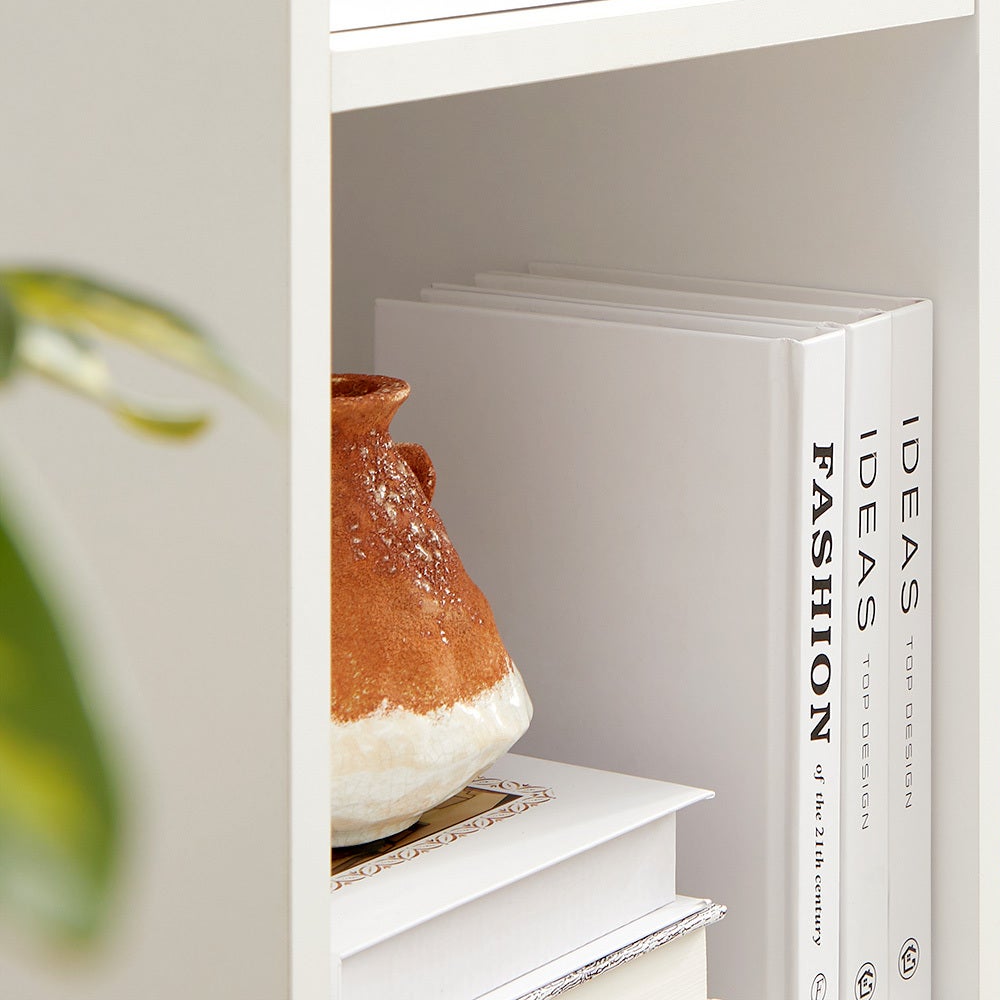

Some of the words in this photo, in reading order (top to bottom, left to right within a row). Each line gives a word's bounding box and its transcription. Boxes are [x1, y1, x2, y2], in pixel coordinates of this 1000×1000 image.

[857, 429, 878, 632] IDEAS
[901, 416, 919, 614] IDEAS
[810, 442, 834, 743] FASHION
[862, 653, 870, 710] TOP
[905, 635, 914, 691] TOP
[814, 764, 825, 784] of
[861, 721, 870, 830] DESIGN
[904, 702, 913, 809] DESIGN
[815, 792, 825, 820] the
[815, 827, 825, 869] 21th
[812, 874, 822, 946] century
